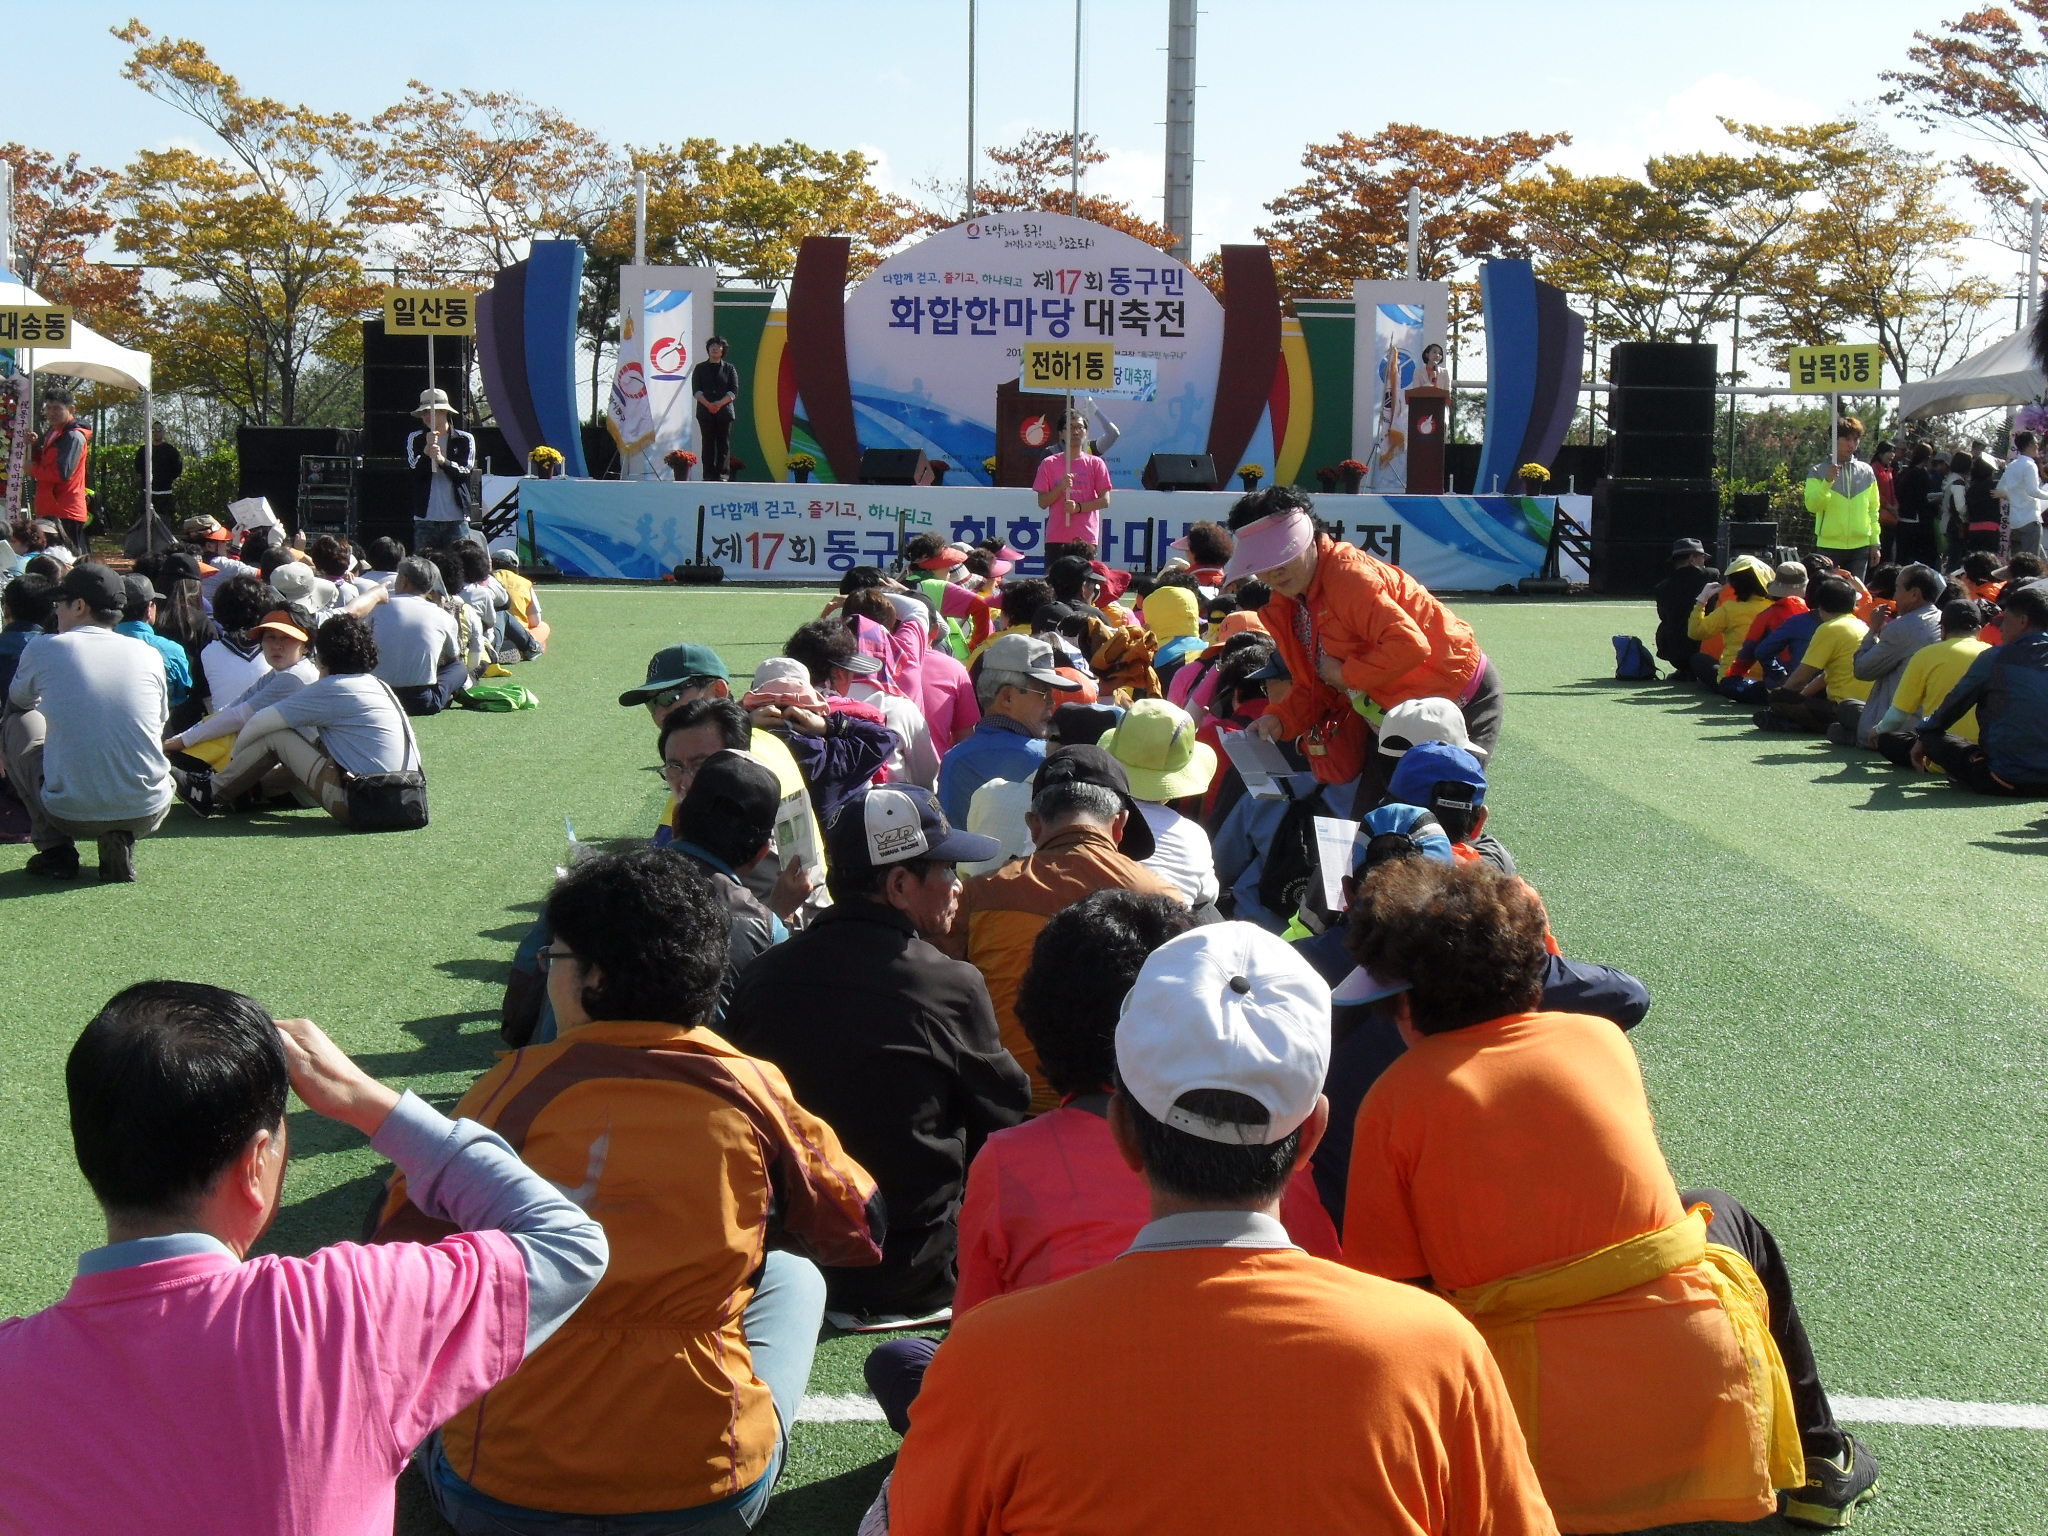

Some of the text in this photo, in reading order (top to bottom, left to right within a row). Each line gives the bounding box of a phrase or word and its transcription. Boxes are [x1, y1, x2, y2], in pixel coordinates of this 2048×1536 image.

[1023, 224, 1042, 238] 동구!
[882, 267, 1184, 296] 다함께 걷고, 즐기고, 하나되고 제17회 동구민
[0, 312, 66, 342] 대송동
[393, 297, 468, 328] 일산동
[888, 295, 1185, 339] 화합한마당 대축전
[1031, 350, 1105, 382] 전하1동
[1113, 366, 1123, 386] 당
[1799, 352, 1870, 385] 남목3동
[711, 500, 933, 526] 다함께 걷고, 즐기고, 하나되고
[711, 530, 816, 571] 제17회
